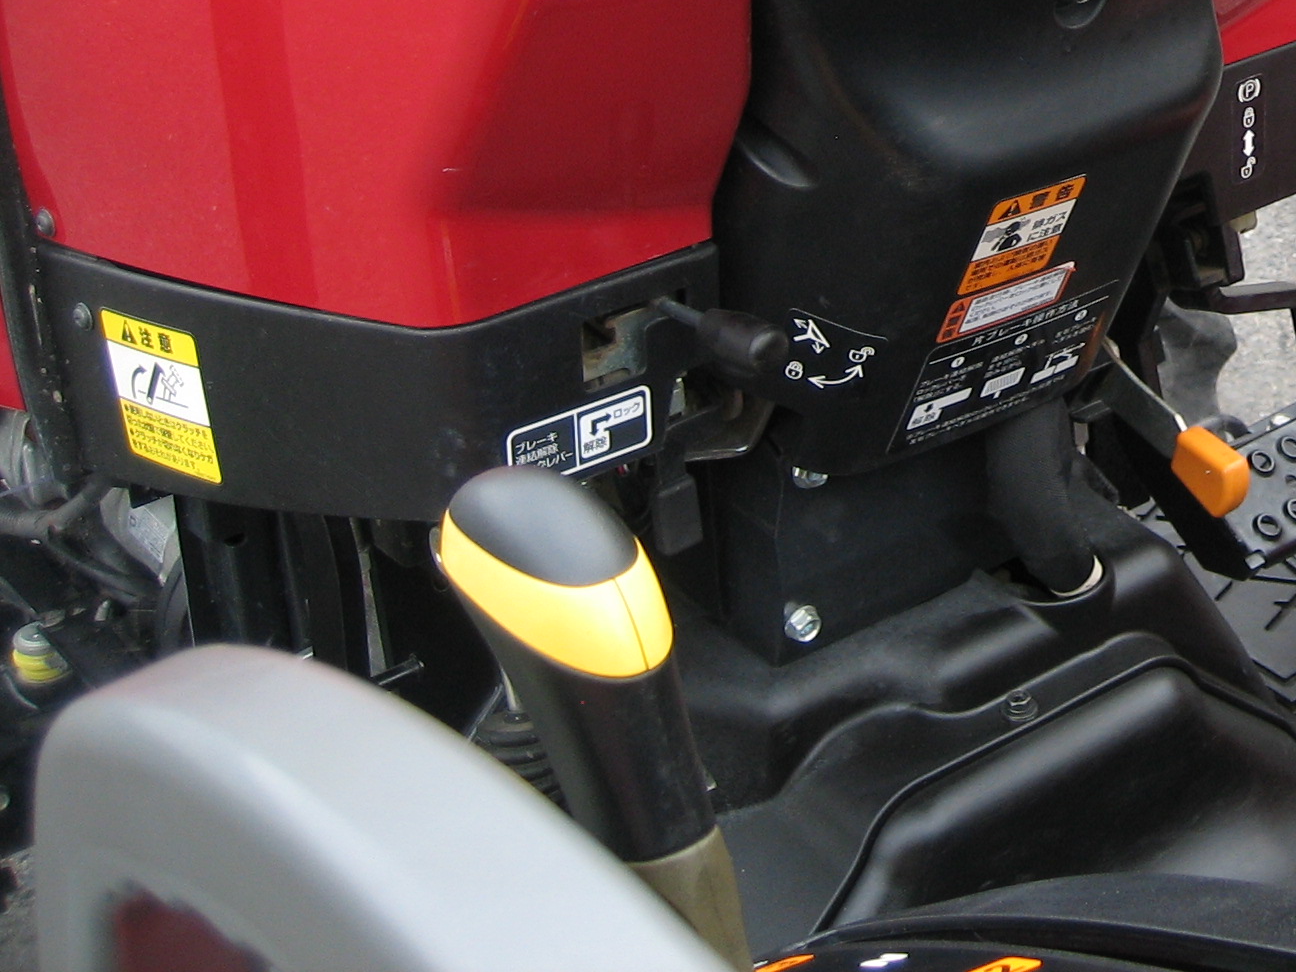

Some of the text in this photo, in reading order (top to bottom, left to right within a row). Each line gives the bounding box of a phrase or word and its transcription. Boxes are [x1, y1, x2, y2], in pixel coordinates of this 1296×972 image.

[612, 401, 641, 420] ロック
[515, 431, 558, 455] ブレーキ
